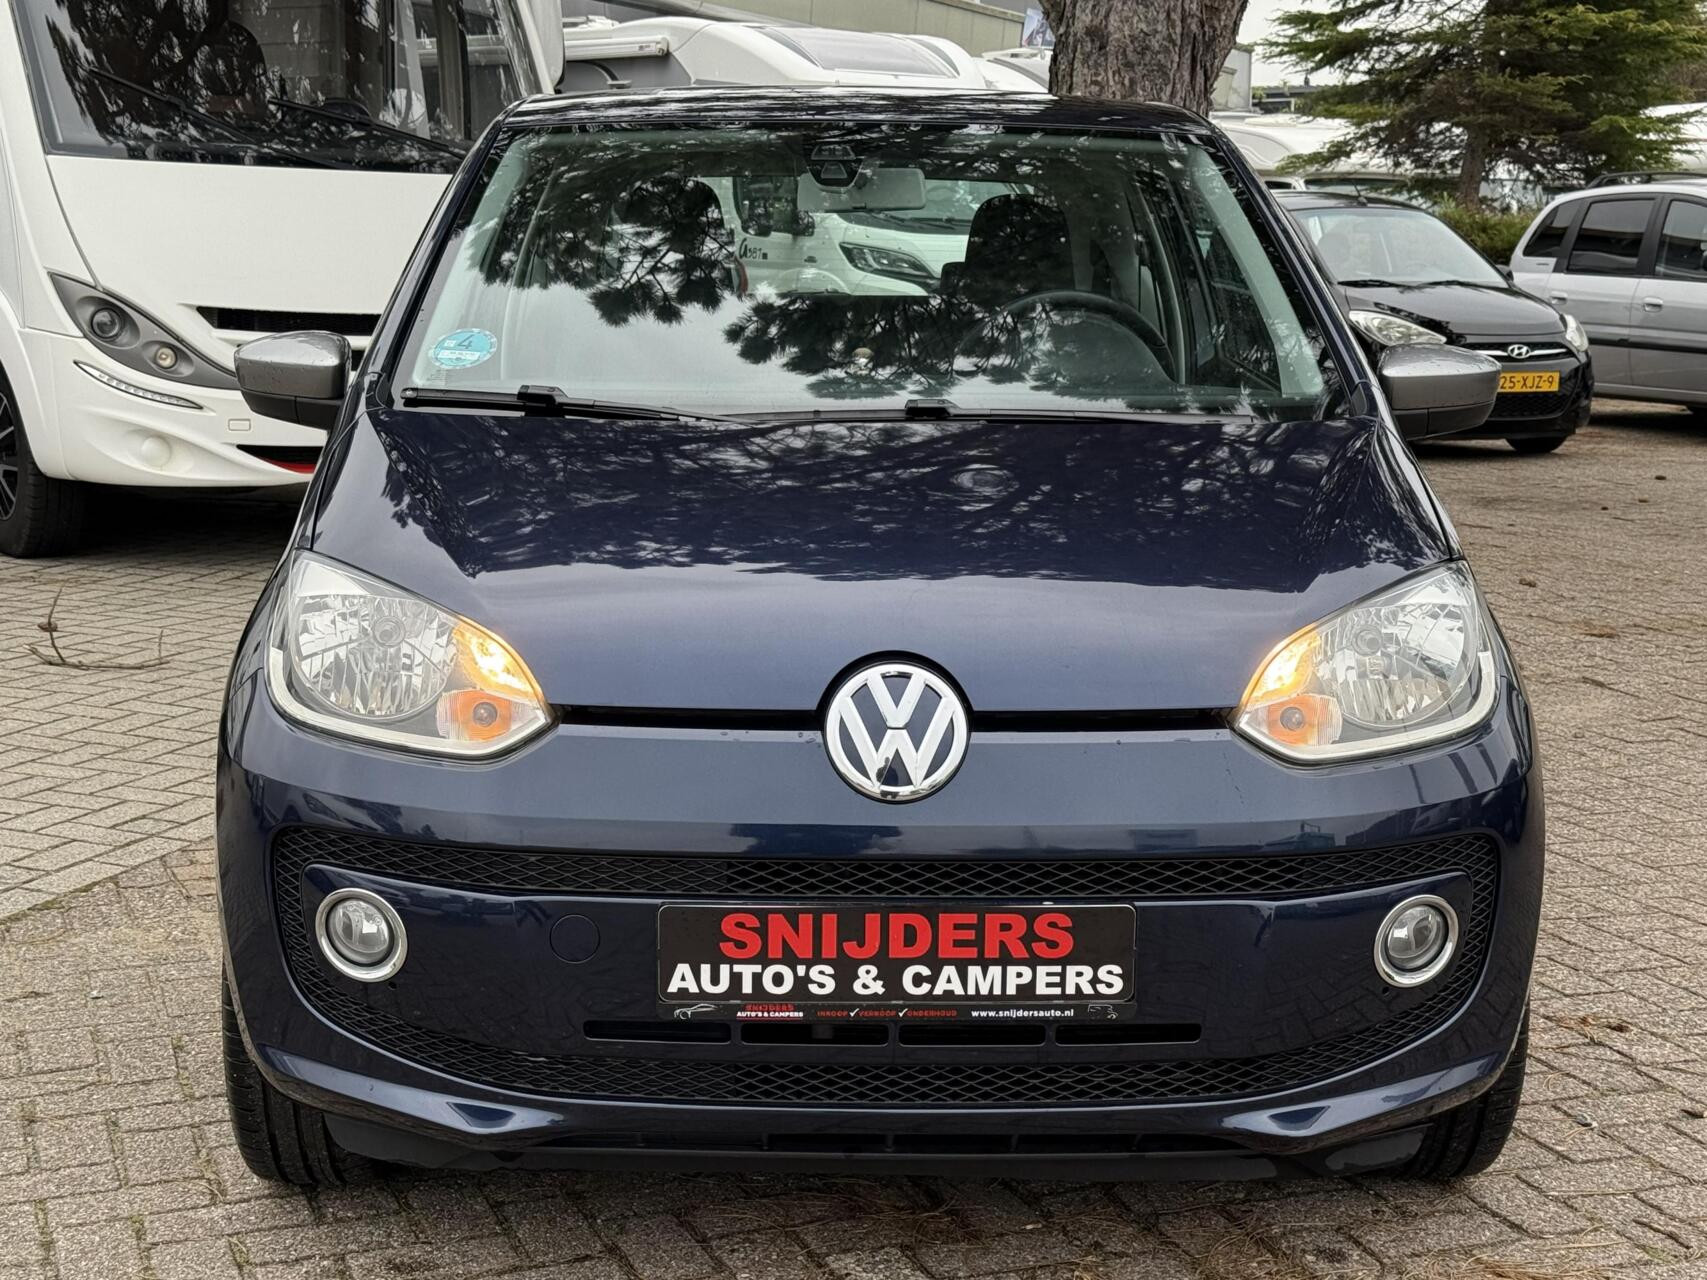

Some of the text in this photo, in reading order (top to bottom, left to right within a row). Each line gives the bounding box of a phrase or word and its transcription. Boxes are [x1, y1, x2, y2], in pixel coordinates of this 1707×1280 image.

[457, 334, 473, 350] 4
[1500, 375, 1554, 390] 25-XJZ-9
[719, 913, 1074, 959] SNIJDERS
[667, 963, 1124, 995] AUTO'S & CAMPERS
[971, 1009, 1074, 1018] www.snijdersauto.nl
